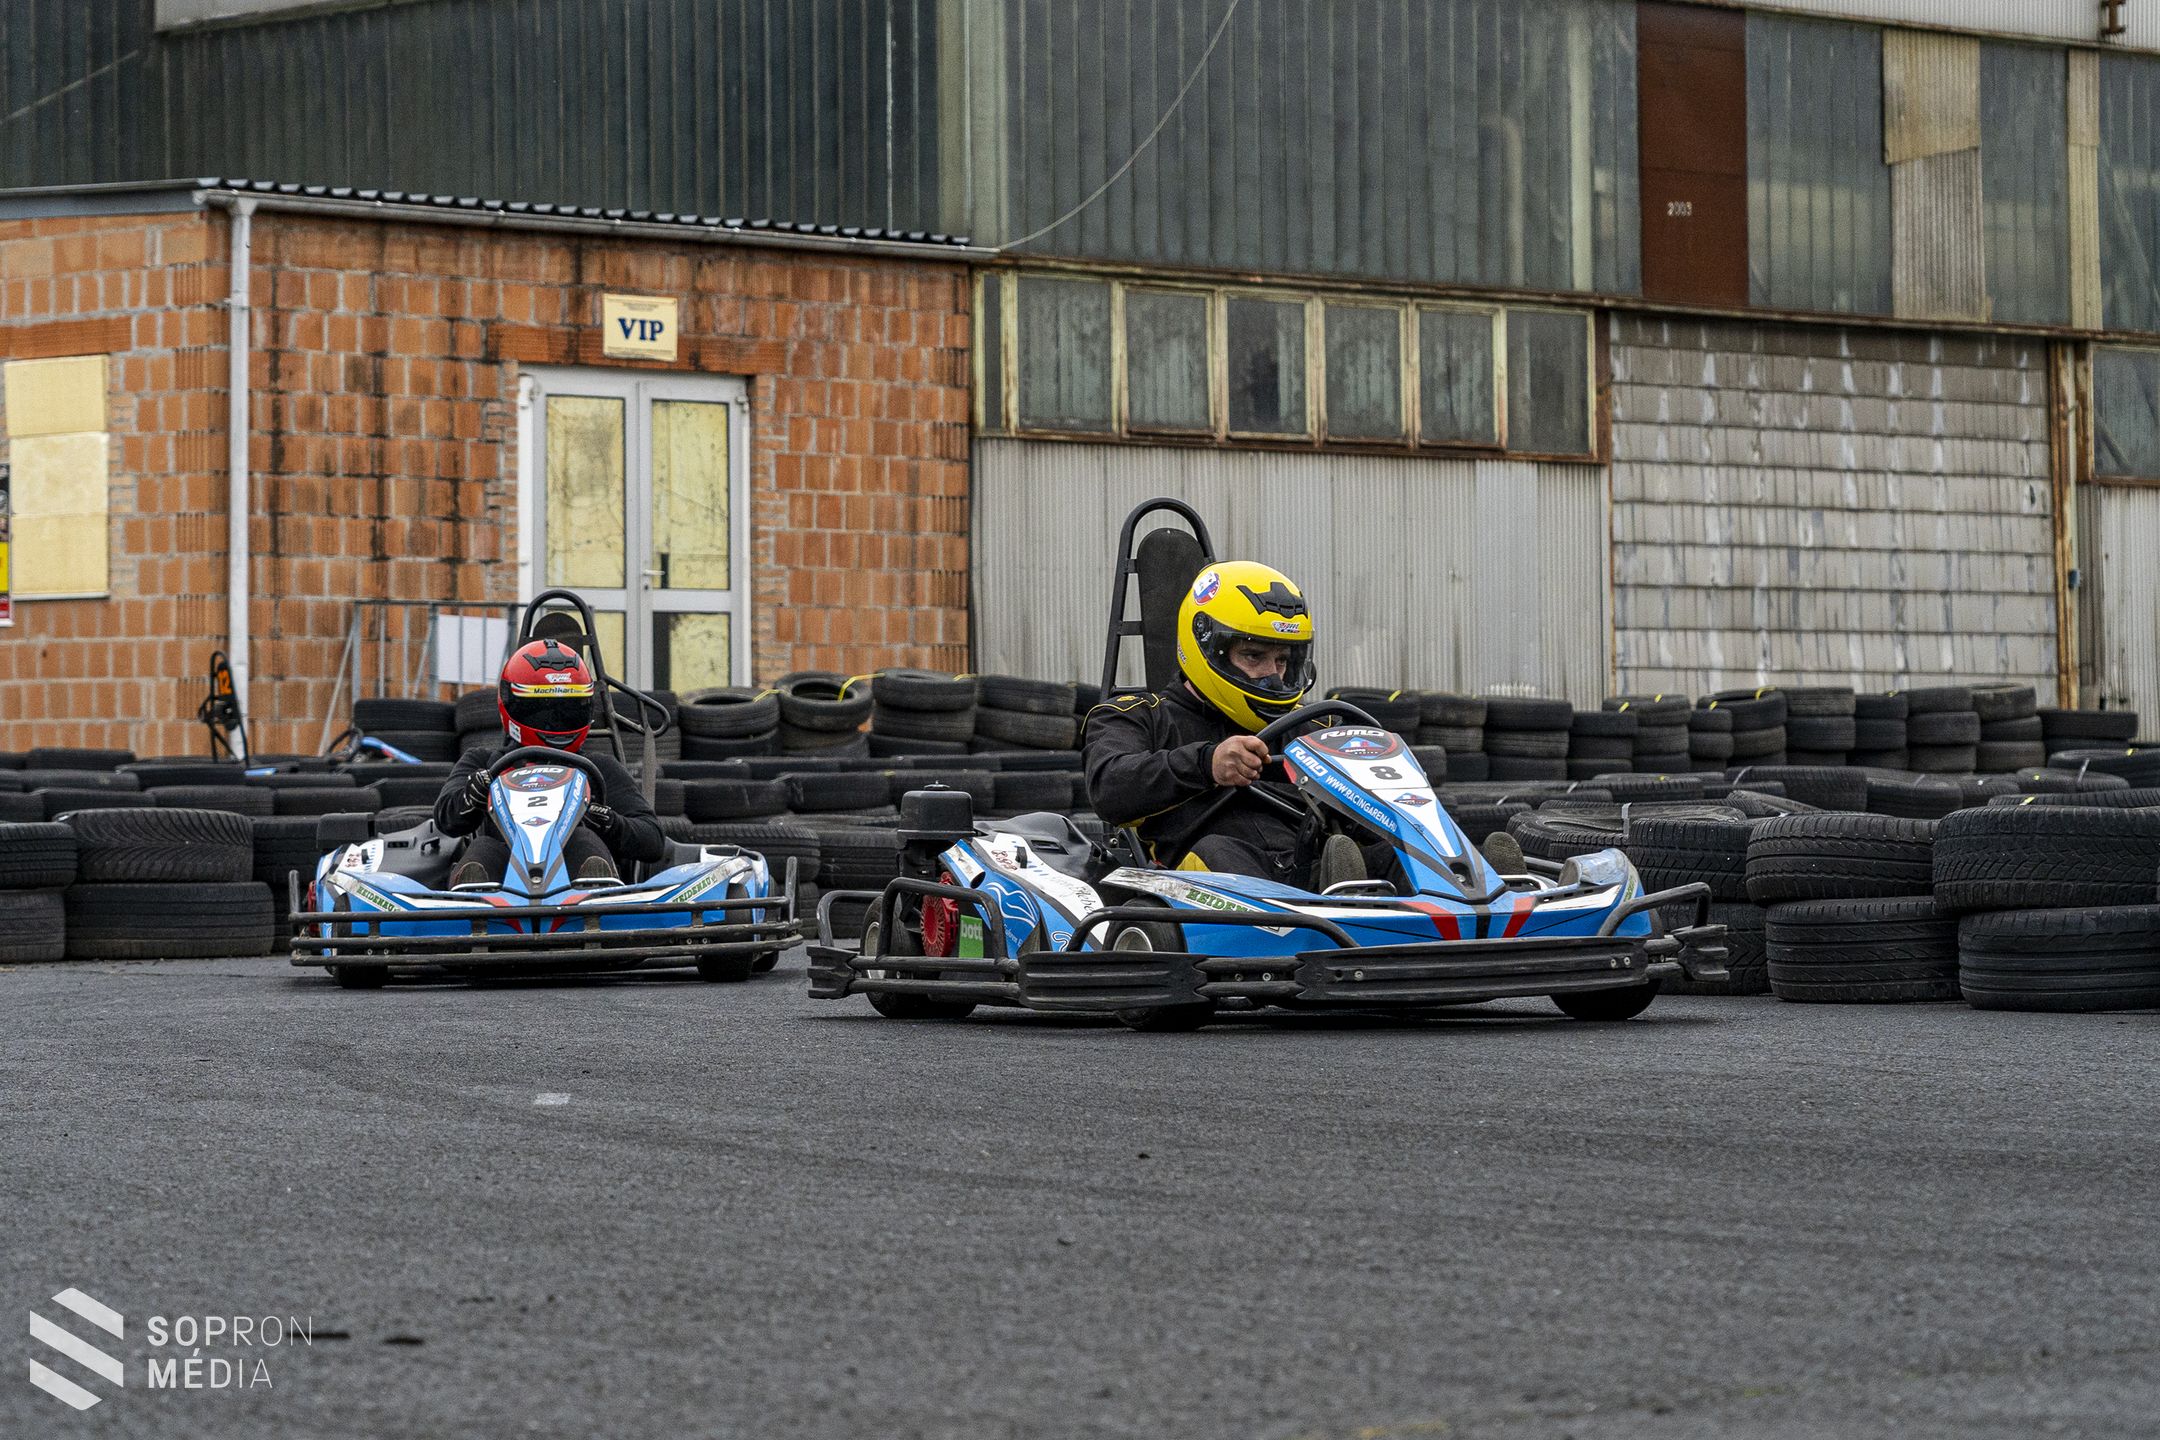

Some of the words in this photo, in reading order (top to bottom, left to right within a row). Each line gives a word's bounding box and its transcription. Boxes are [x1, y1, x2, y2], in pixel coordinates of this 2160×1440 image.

[618, 318, 664, 341] VIP
[1369, 766, 1402, 780] 8
[528, 796, 548, 807] 2
[1325, 775, 1398, 832] WWW.RACINGARENA.HU
